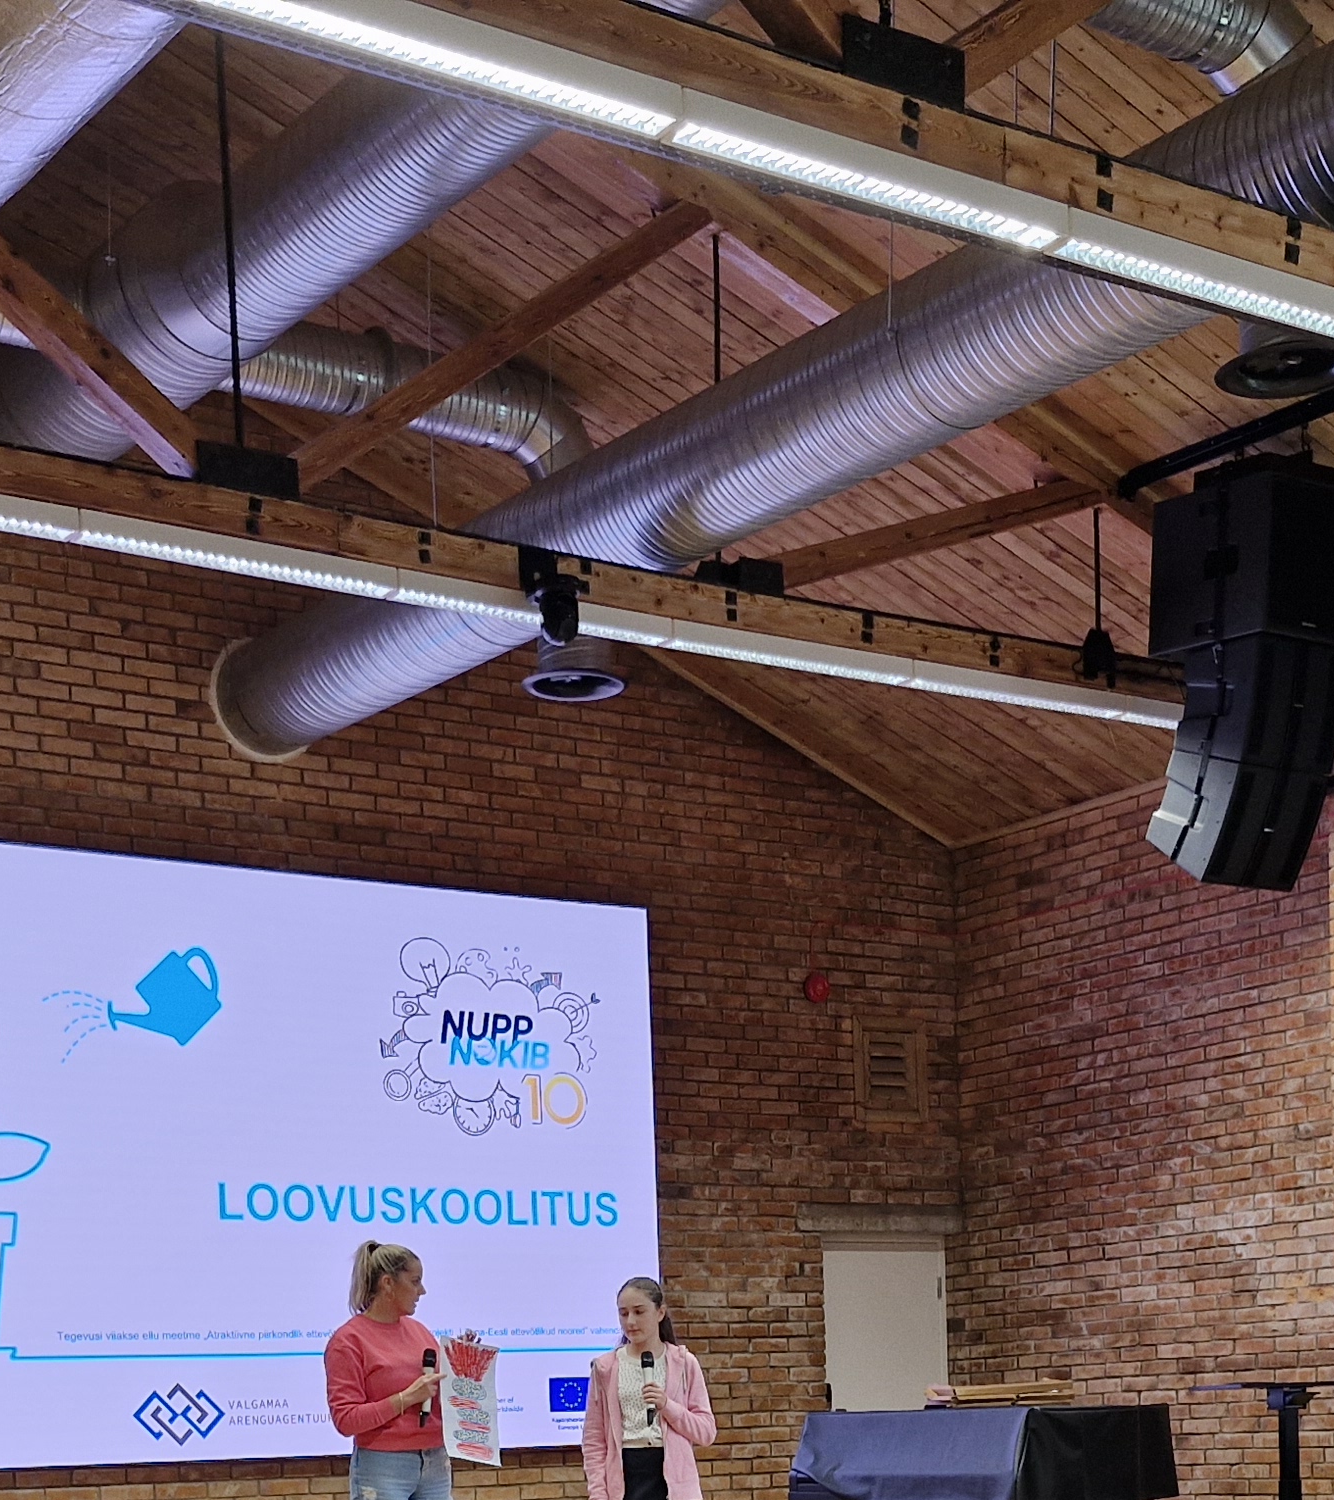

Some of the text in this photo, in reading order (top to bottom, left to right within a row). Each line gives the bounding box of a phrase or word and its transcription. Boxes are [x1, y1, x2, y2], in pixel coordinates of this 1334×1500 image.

[440, 1009, 533, 1044] NUPP
[522, 1073, 588, 1128] 10
[218, 1182, 619, 1228] LOOVUSKOOLITUS
[57, 1331, 102, 1343] Tegevusi
[106, 1331, 139, 1340] viiakse
[142, 1330, 159, 1340] ellu
[162, 1331, 200, 1340] meetme
[228, 1399, 289, 1410] VALGAMAA
